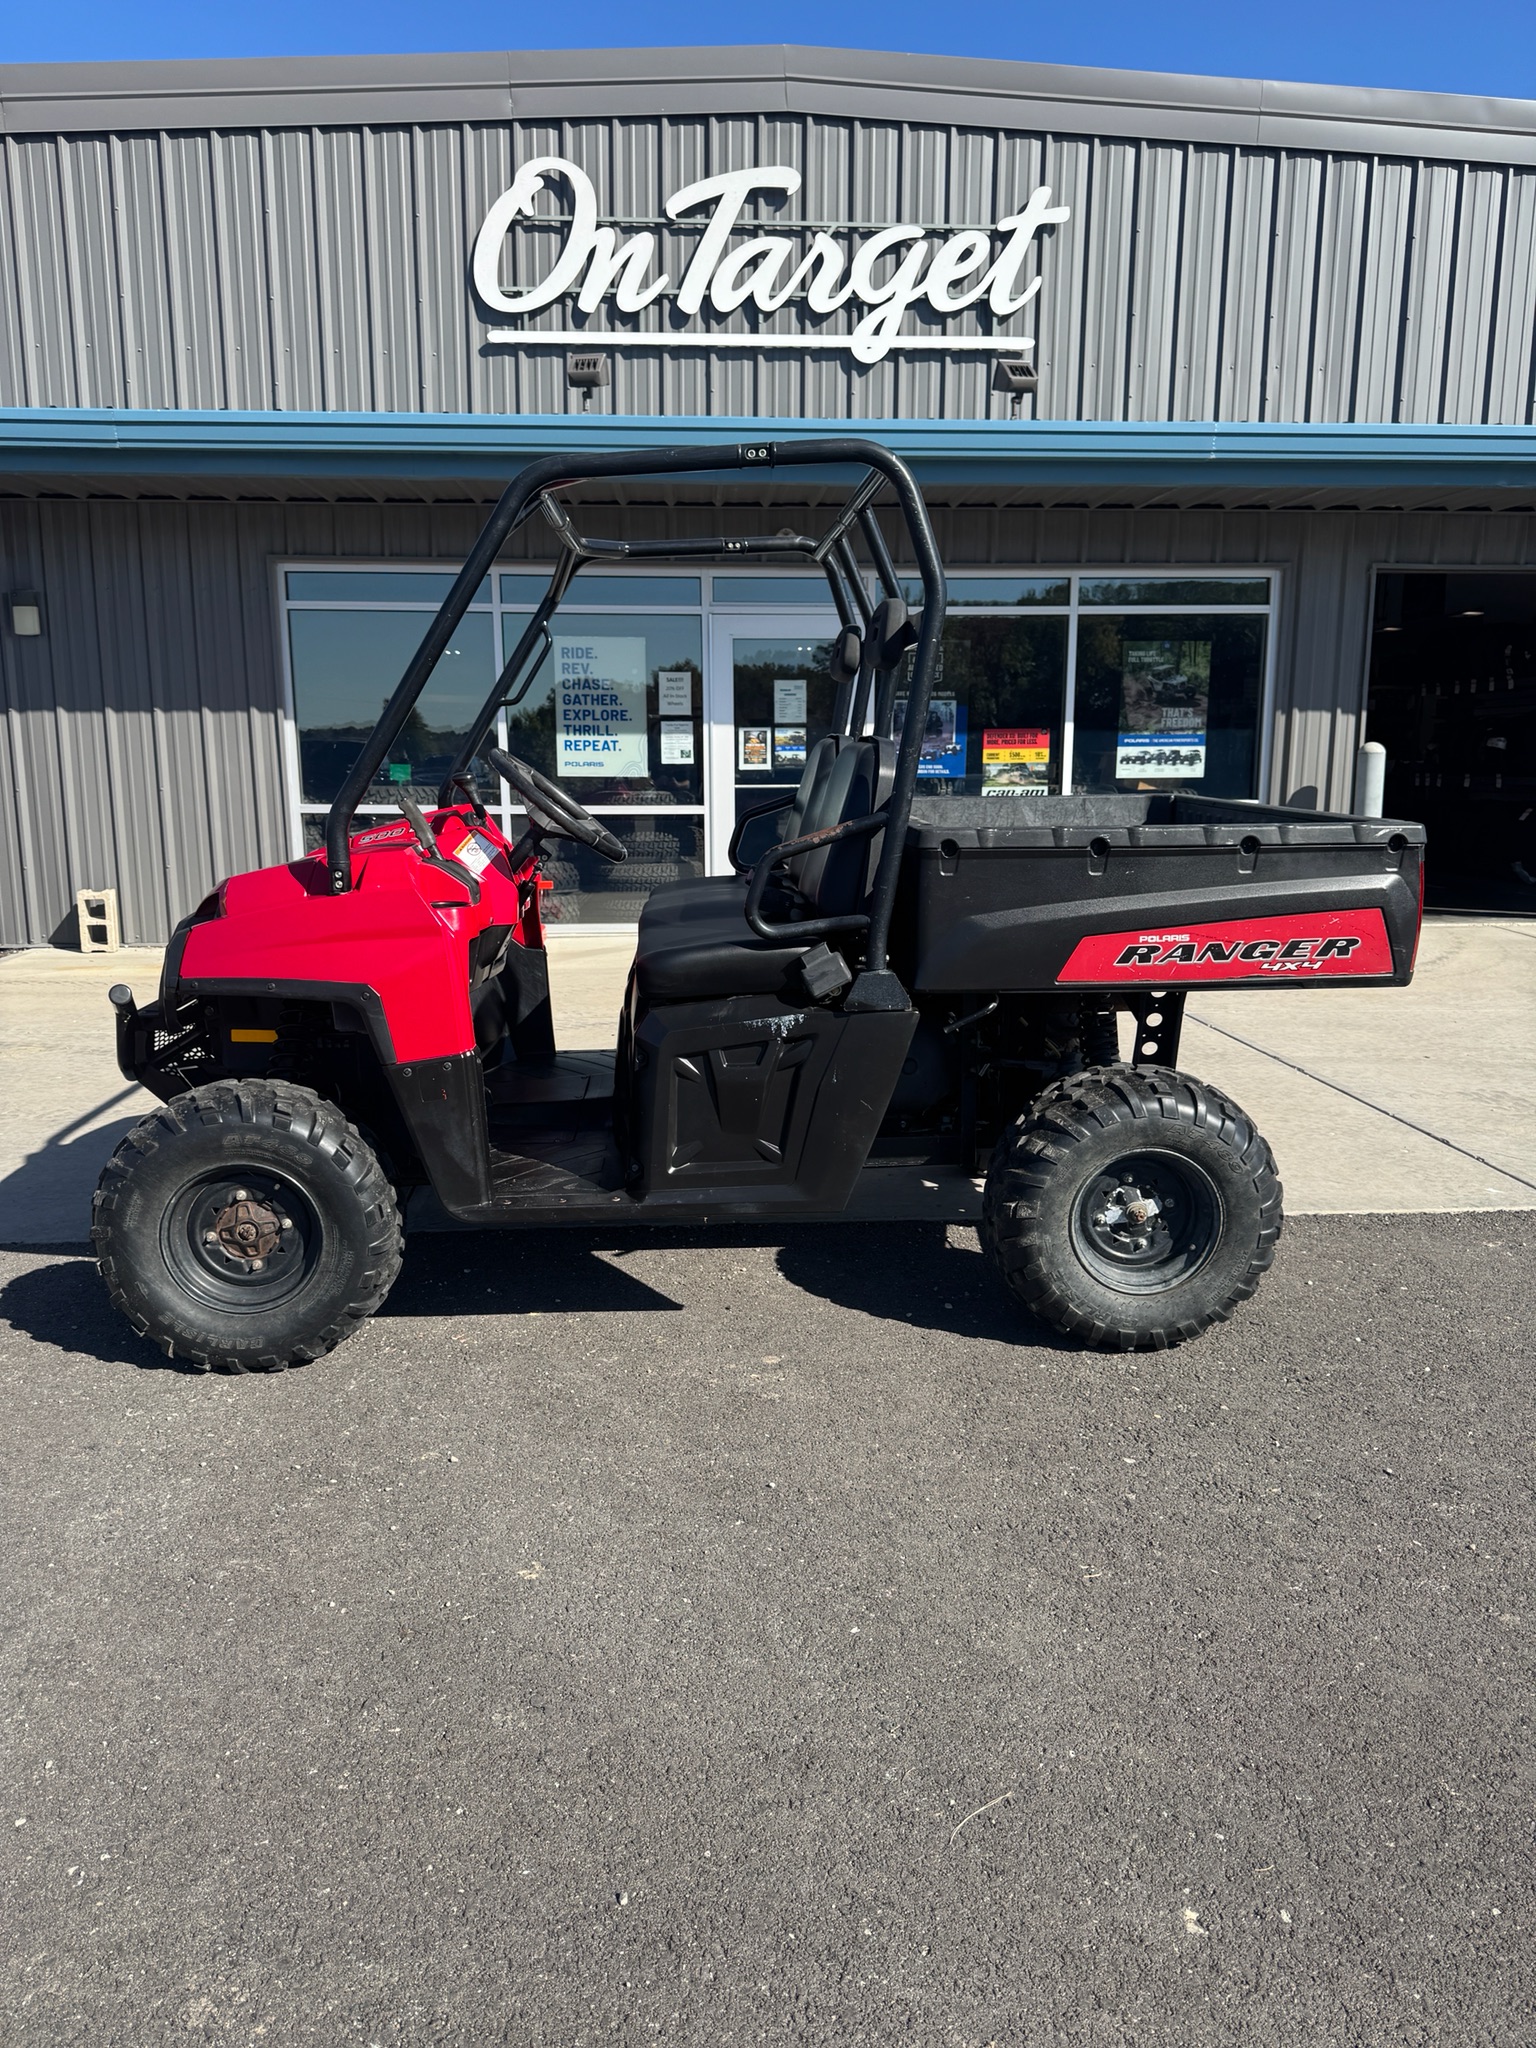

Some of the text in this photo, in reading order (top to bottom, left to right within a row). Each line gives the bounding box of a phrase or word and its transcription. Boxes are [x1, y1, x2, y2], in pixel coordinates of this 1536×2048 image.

[473, 156, 1071, 365] On Target
[561, 646, 598, 660] RIDE.
[561, 662, 594, 675] REV.
[562, 678, 614, 691] CHASE.
[562, 694, 623, 706] GATHER.
[563, 709, 633, 722] EXPLORE.
[1161, 707, 1194, 718] THAT'S
[1160, 717, 1202, 728] FREEDOM
[563, 724, 619, 737] THRILL.
[564, 739, 622, 752] REPEAT.
[986, 788, 1046, 797] can-am
[357, 826, 407, 845] 500
[1138, 933, 1191, 943] POLARIS
[1112, 936, 1362, 967] RANGER
[1049, 1269, 1139, 1328] CARLISLE
[157, 1310, 265, 1350] CARLISLE
